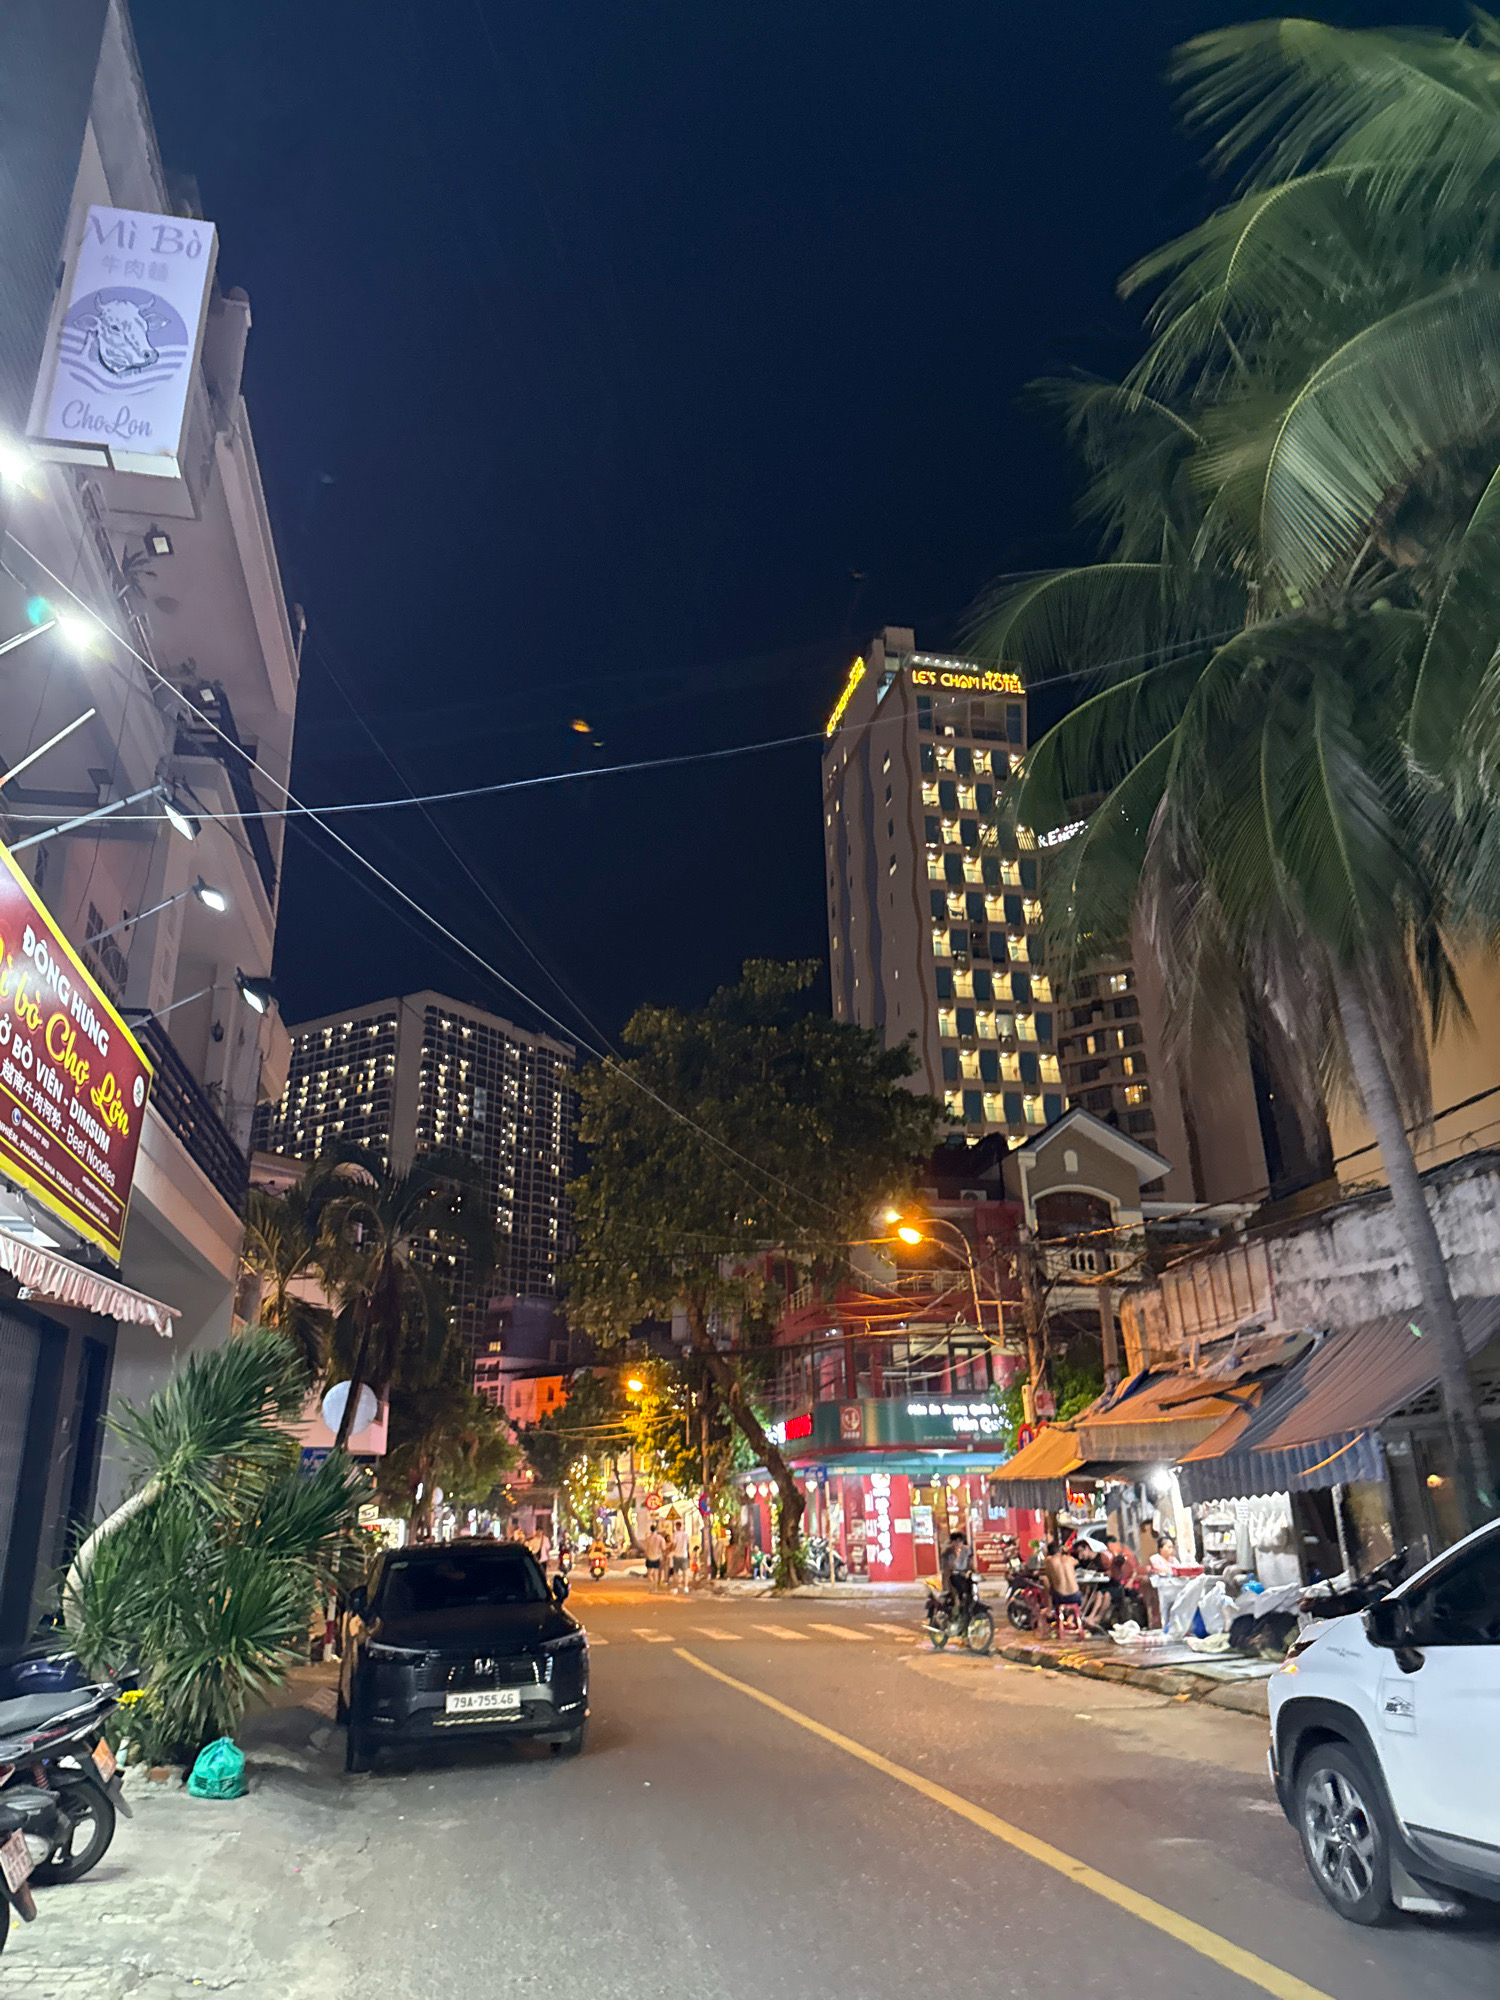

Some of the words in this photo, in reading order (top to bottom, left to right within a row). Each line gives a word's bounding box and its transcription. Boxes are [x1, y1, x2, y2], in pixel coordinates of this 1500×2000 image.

[83, 214, 138, 250] Mì
[150, 223, 203, 259] Bò
[981, 676, 1026, 694] HOTEL
[70, 990, 110, 1057] HƯNG
[11, 1033, 33, 1070] BÒ
[36, 1057, 64, 1104] VIÊN
[69, 1096, 111, 1155] DIMSUM
[45, 1012, 90, 1095] Chợ
[90, 1072, 130, 1136] Lớn
[66, 1124, 88, 1158] Beef
[86, 1144, 116, 1188] Noodles
